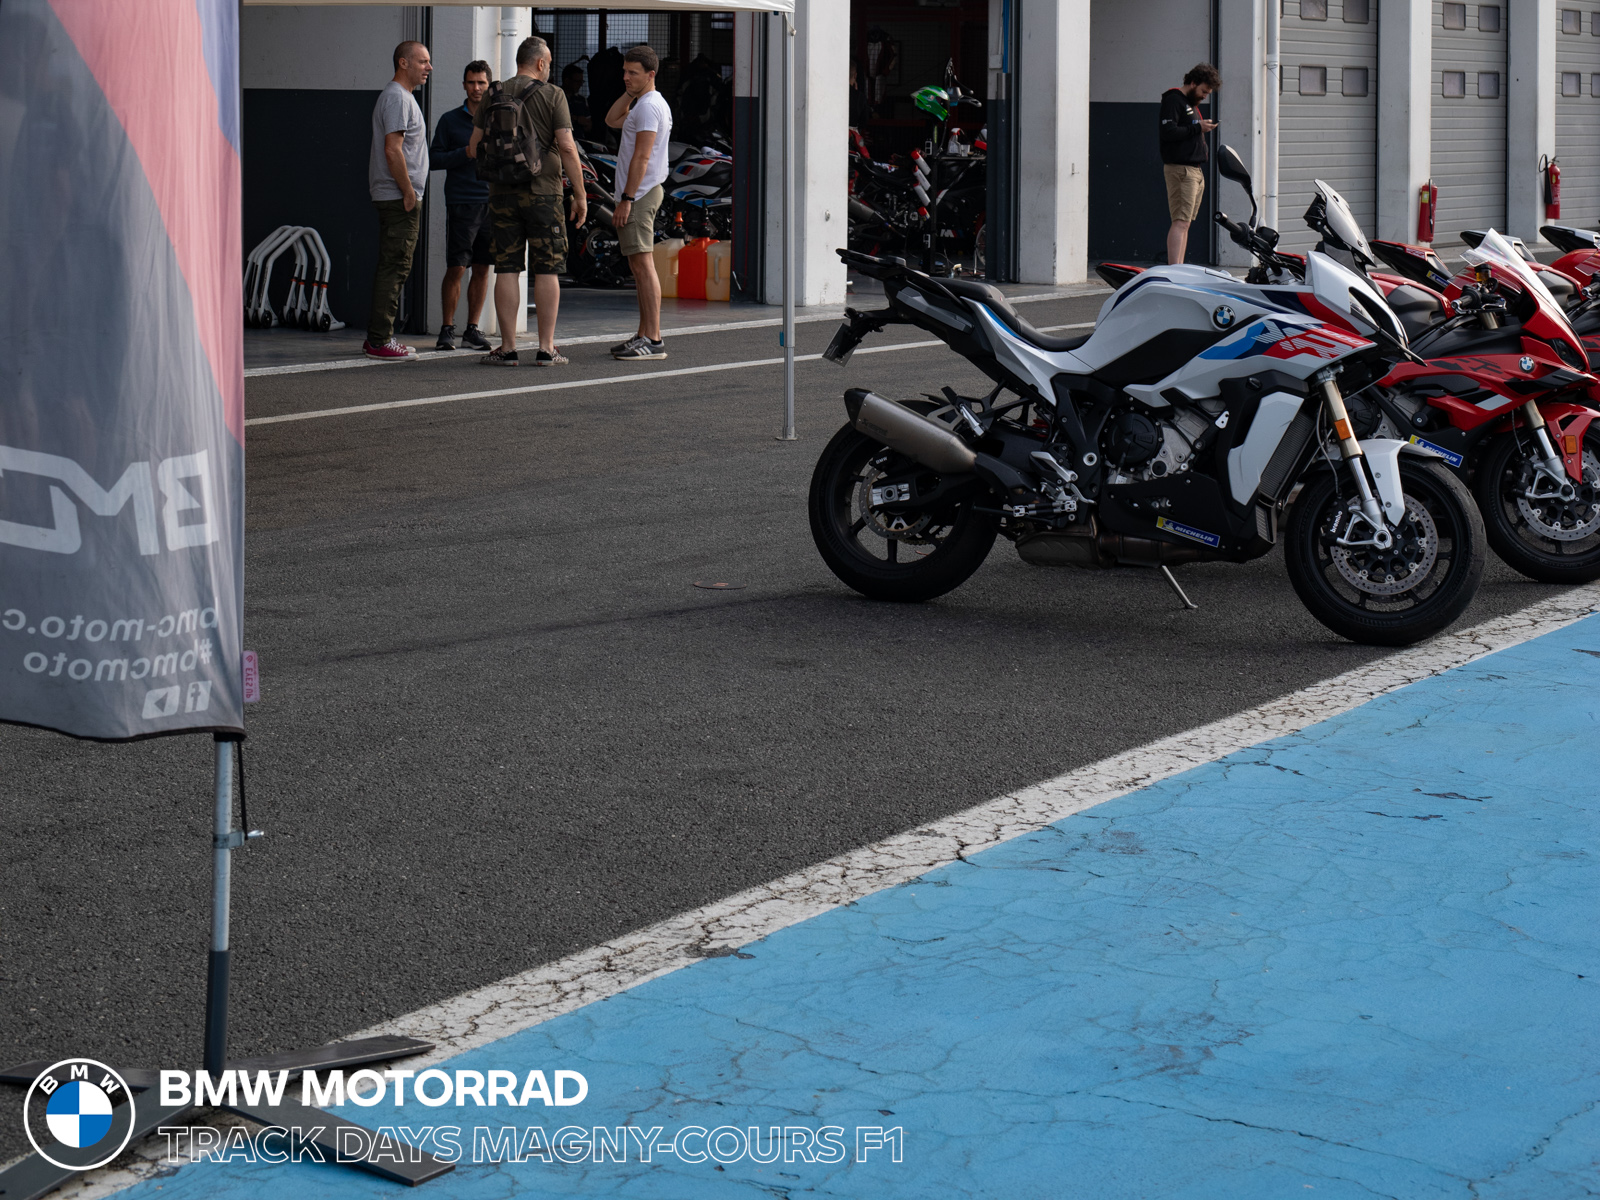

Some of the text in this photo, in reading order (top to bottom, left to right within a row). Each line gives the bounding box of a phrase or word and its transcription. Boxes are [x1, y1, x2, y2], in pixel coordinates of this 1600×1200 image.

[1425, 445, 1459, 463] MICHELIN
[1329, 510, 1343, 534] brembo
[1174, 525, 1215, 542] MICHELIN
